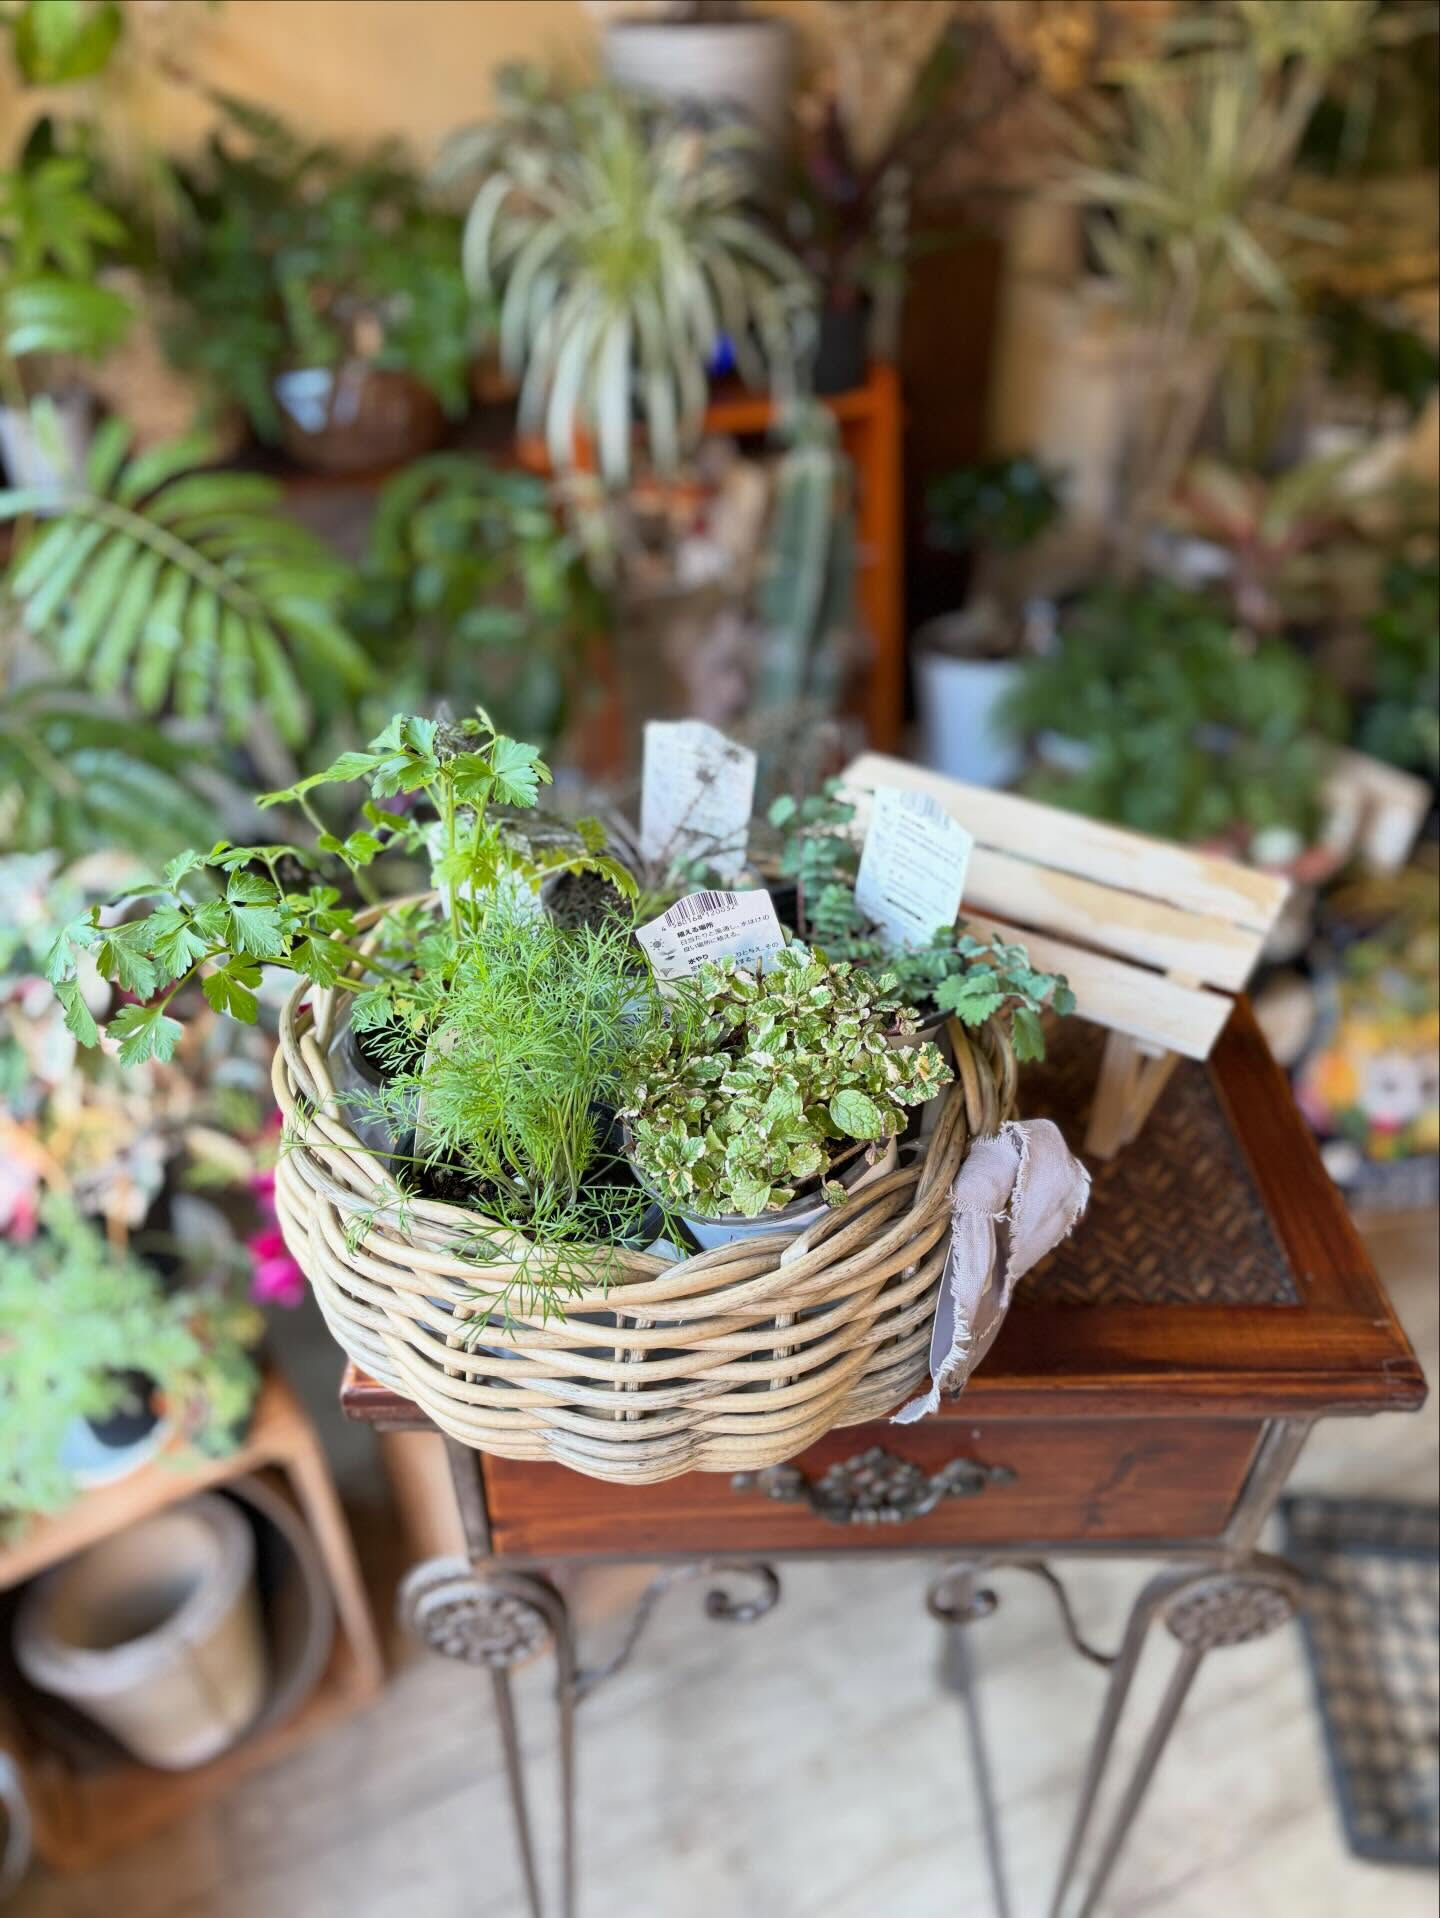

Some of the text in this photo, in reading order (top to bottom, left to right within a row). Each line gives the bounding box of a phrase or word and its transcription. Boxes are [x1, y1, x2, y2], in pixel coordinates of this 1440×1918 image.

[671, 913, 703, 929] 580168
[706, 905, 736, 917] 120032
[677, 921, 714, 938] 植える場所
[687, 954, 709, 965] 水やり
